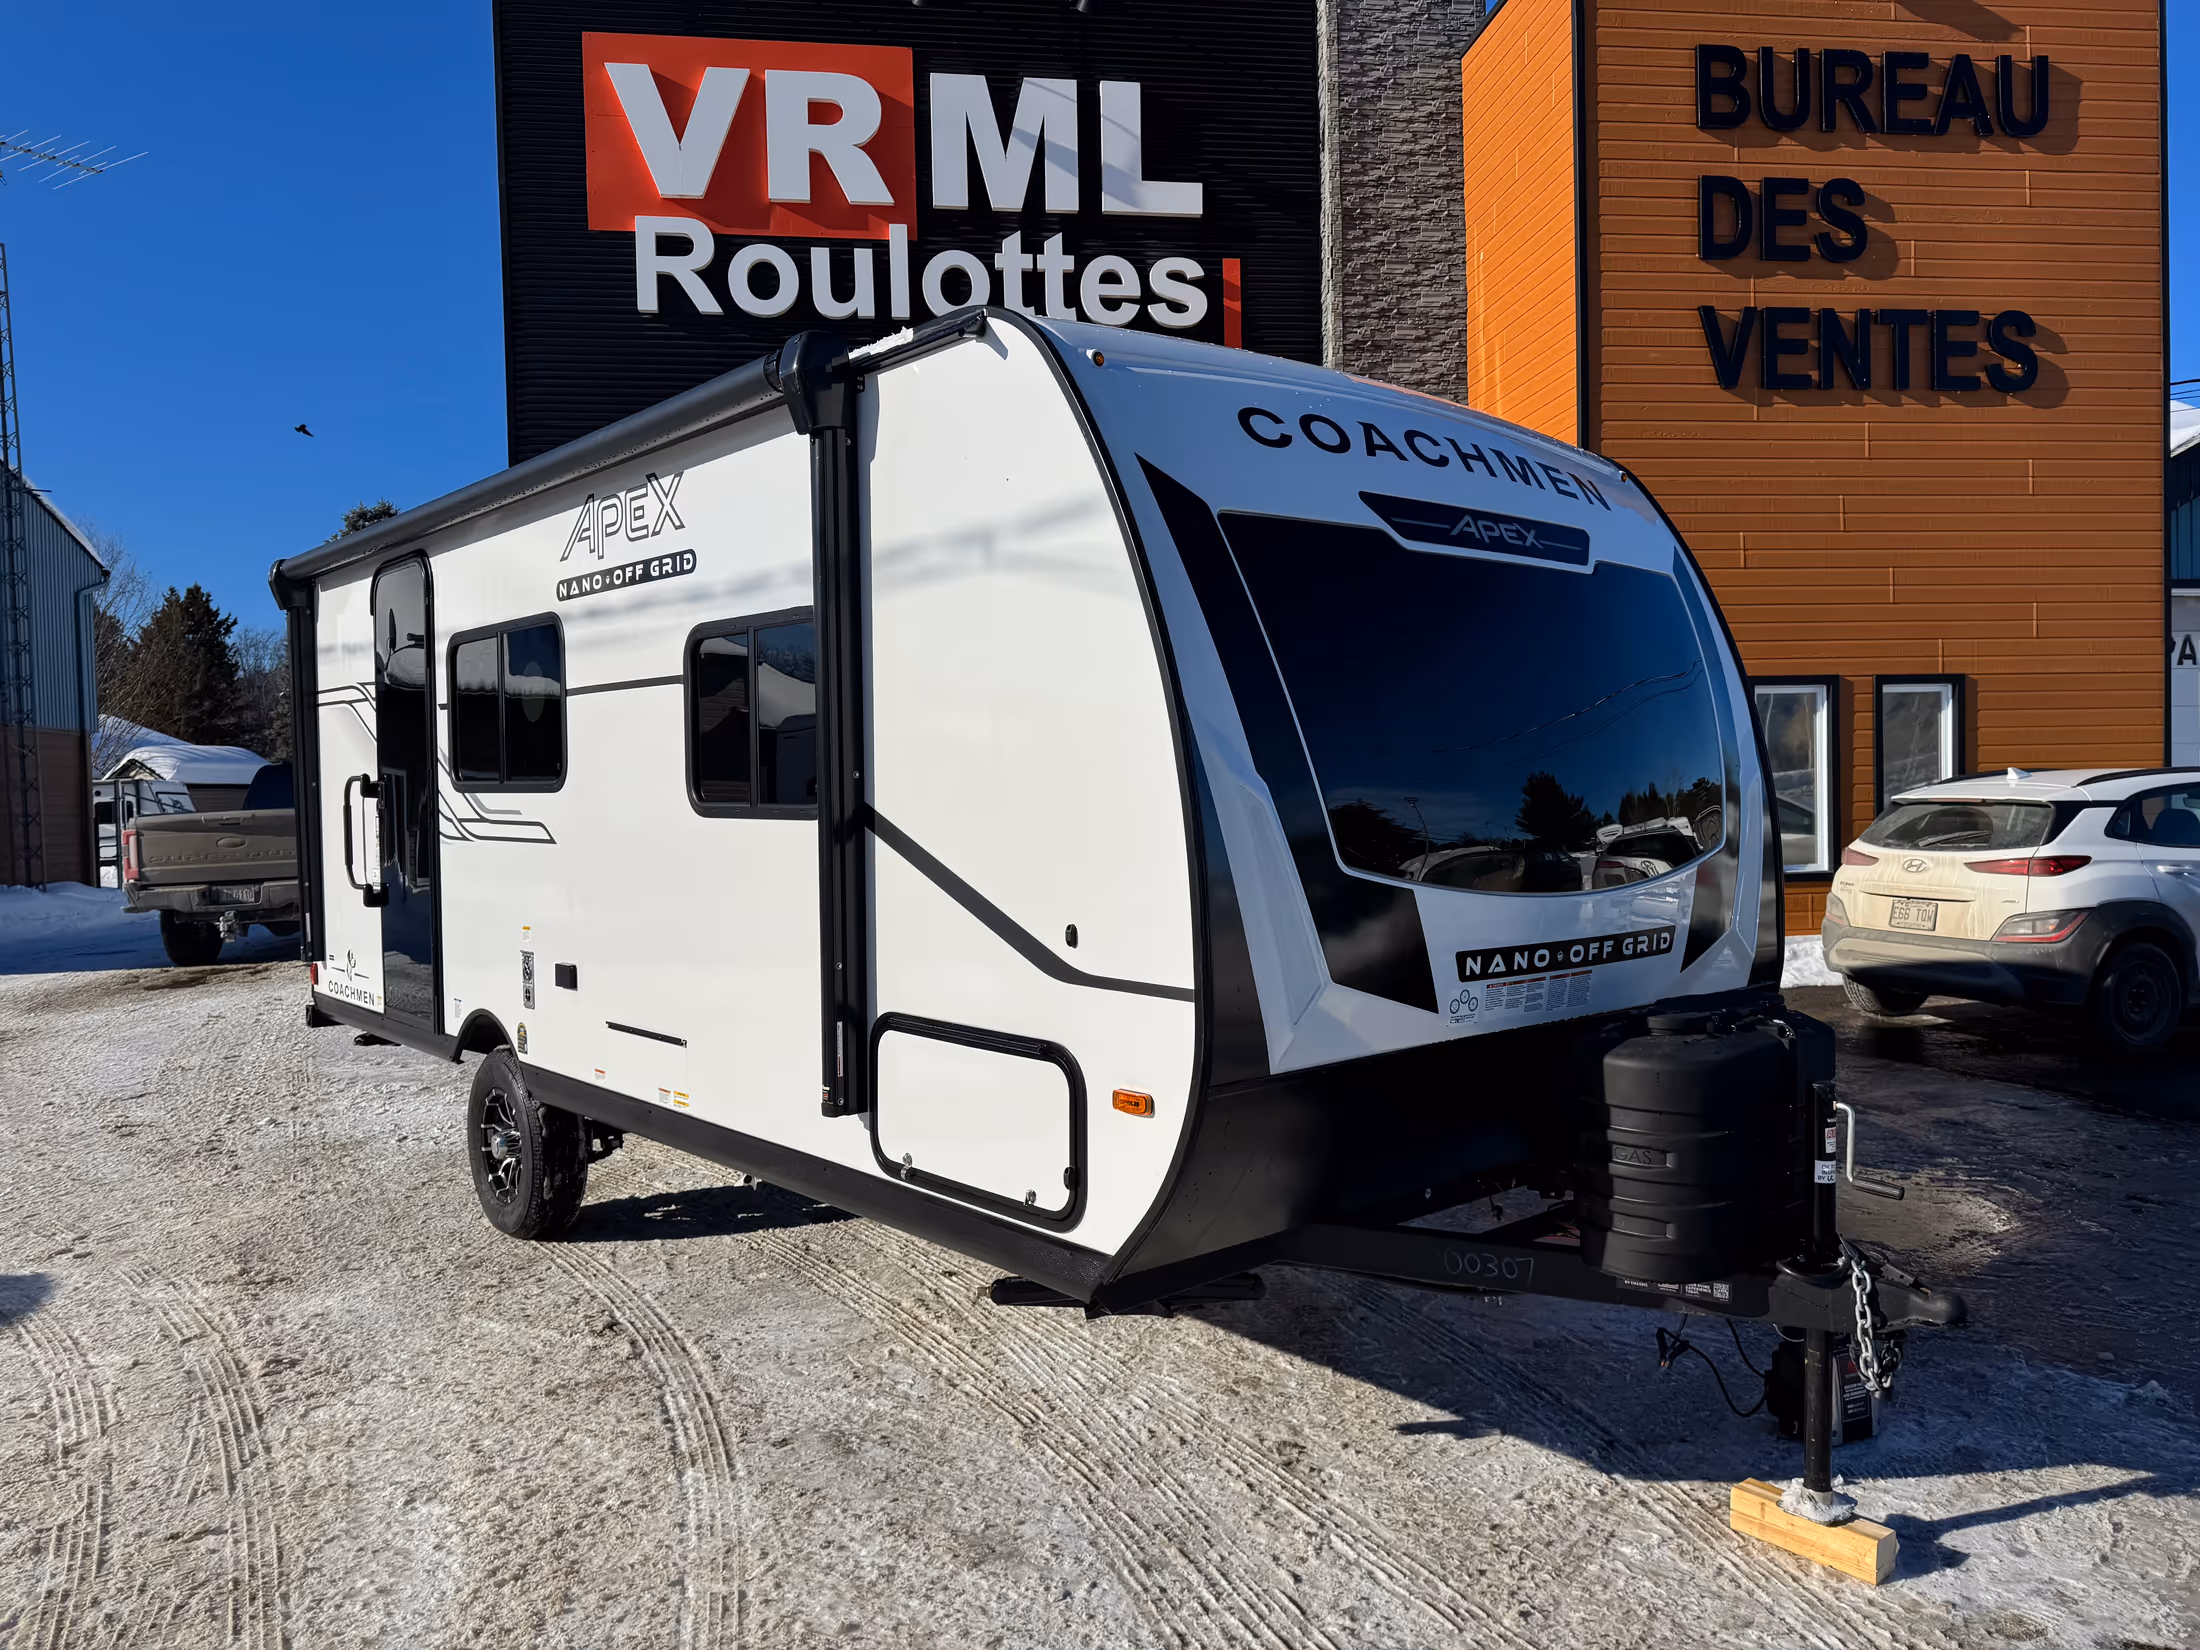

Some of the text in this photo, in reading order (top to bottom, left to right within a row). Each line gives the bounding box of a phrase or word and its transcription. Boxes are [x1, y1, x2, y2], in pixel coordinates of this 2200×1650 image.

[1695, 43, 2050, 138] BUREAU
[603, 61, 1204, 218] VRML
[1697, 174, 1868, 263] DES
[633, 214, 1209, 329] Roulottes
[1697, 304, 2040, 394] VENTES
[1236, 405, 1613, 512] COACHMEN
[559, 470, 686, 562] APEX
[1449, 513, 1545, 550] APEX
[558, 552, 694, 599] NANO OFF GRID
[2177, 633, 2197, 666] A
[328, 979, 375, 1007] COACHMEN
[1465, 931, 1672, 976] NANO OFF GRID
[1614, 1146, 1652, 1165] GAS
